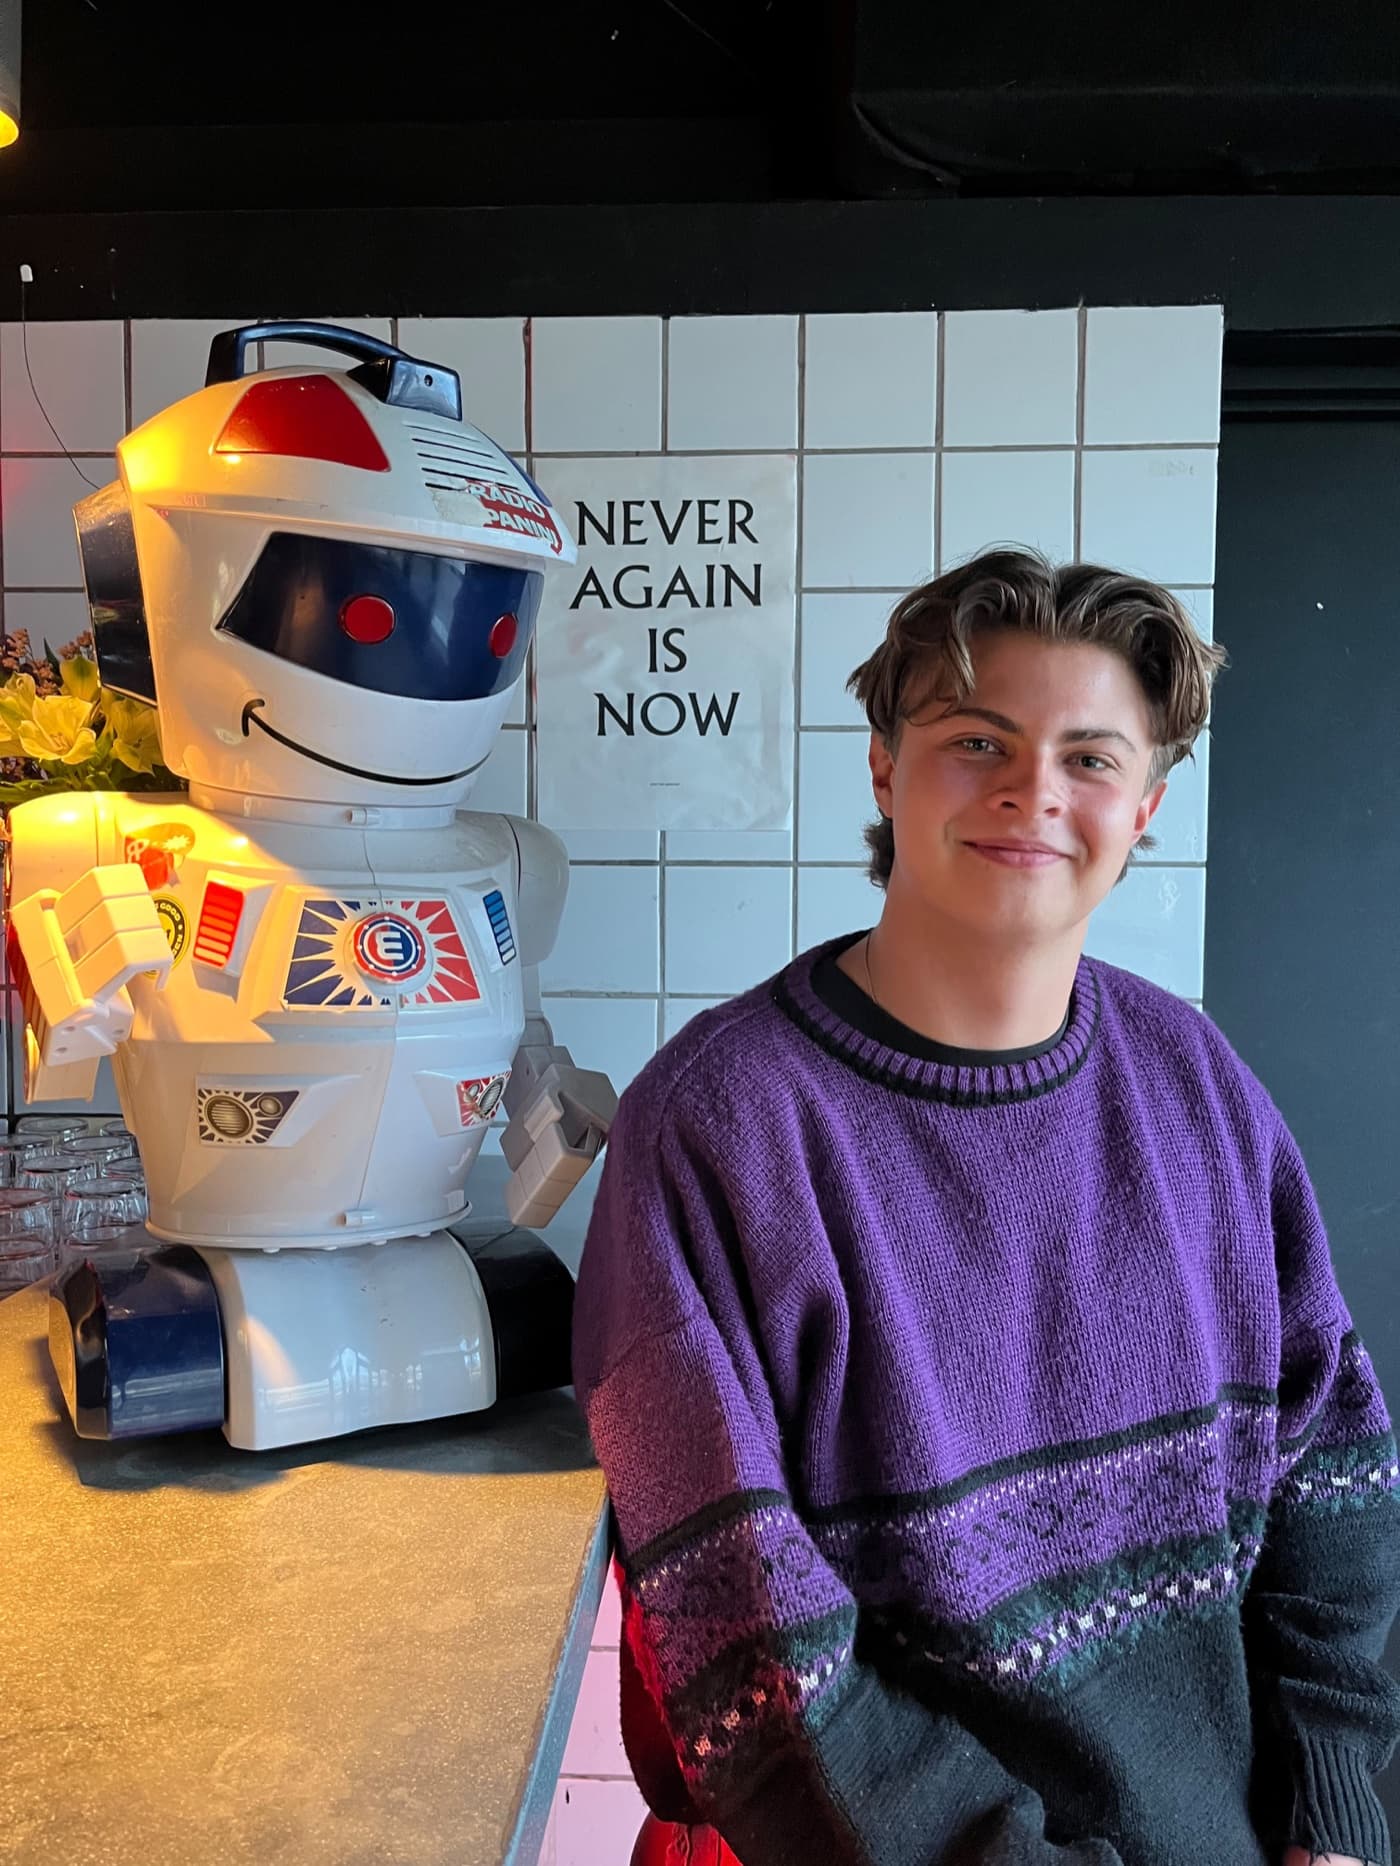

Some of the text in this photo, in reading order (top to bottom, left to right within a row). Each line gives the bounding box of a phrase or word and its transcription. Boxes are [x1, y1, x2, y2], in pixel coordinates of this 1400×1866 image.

[468, 484, 546, 519] RADIO
[573, 499, 759, 546] NEVER
[569, 563, 762, 610] AGAIN
[648, 627, 687, 673] IS
[594, 692, 740, 737] NOW
[159, 902, 181, 922] GOOD
